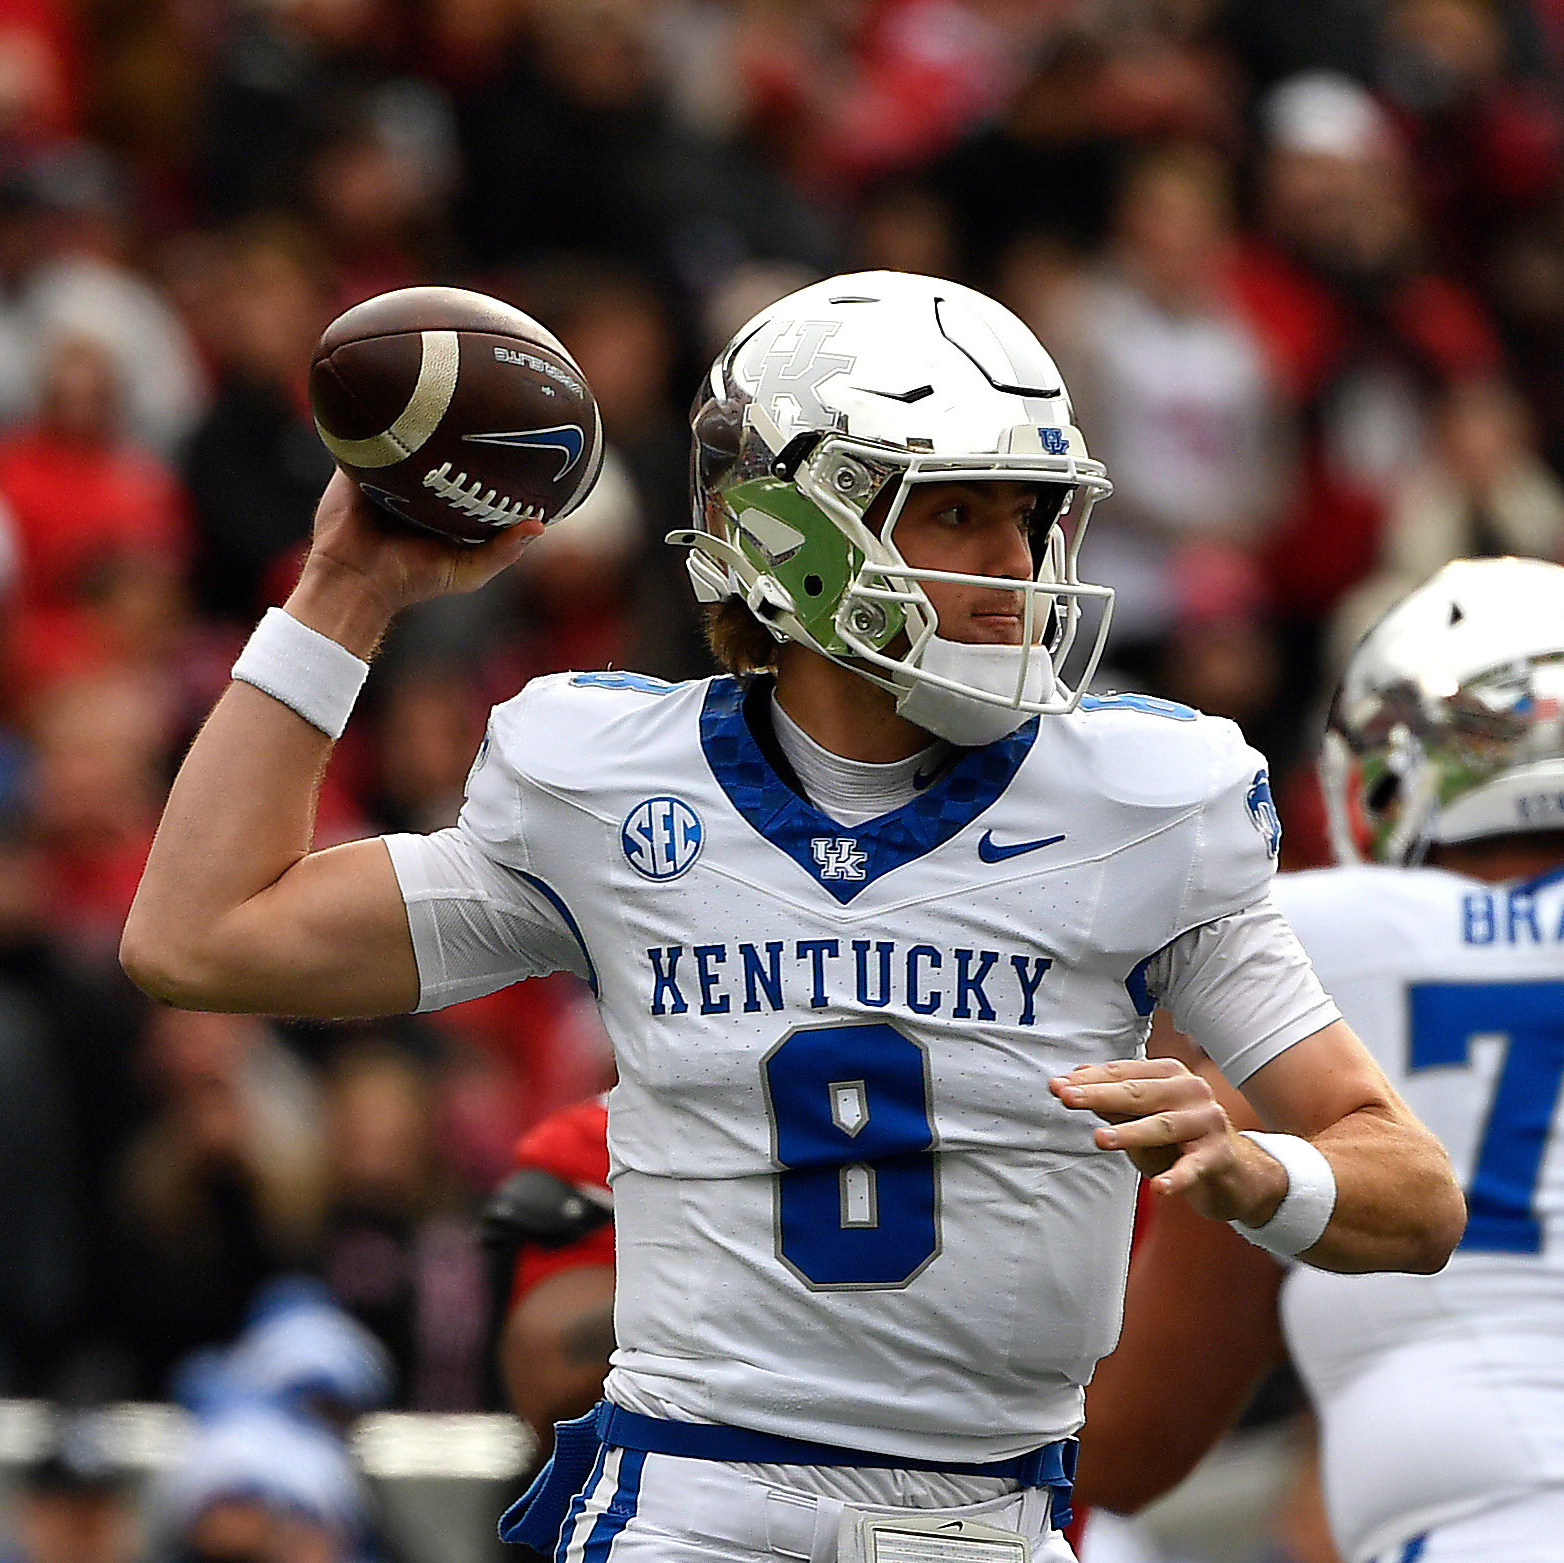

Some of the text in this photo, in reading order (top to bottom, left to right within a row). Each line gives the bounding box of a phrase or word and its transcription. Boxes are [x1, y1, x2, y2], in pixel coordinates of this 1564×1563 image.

[625, 800, 697, 875] SEC
[810, 837, 868, 881] UK
[647, 938, 1054, 1027] KENTUCKY
[758, 1021, 943, 1292] 8
